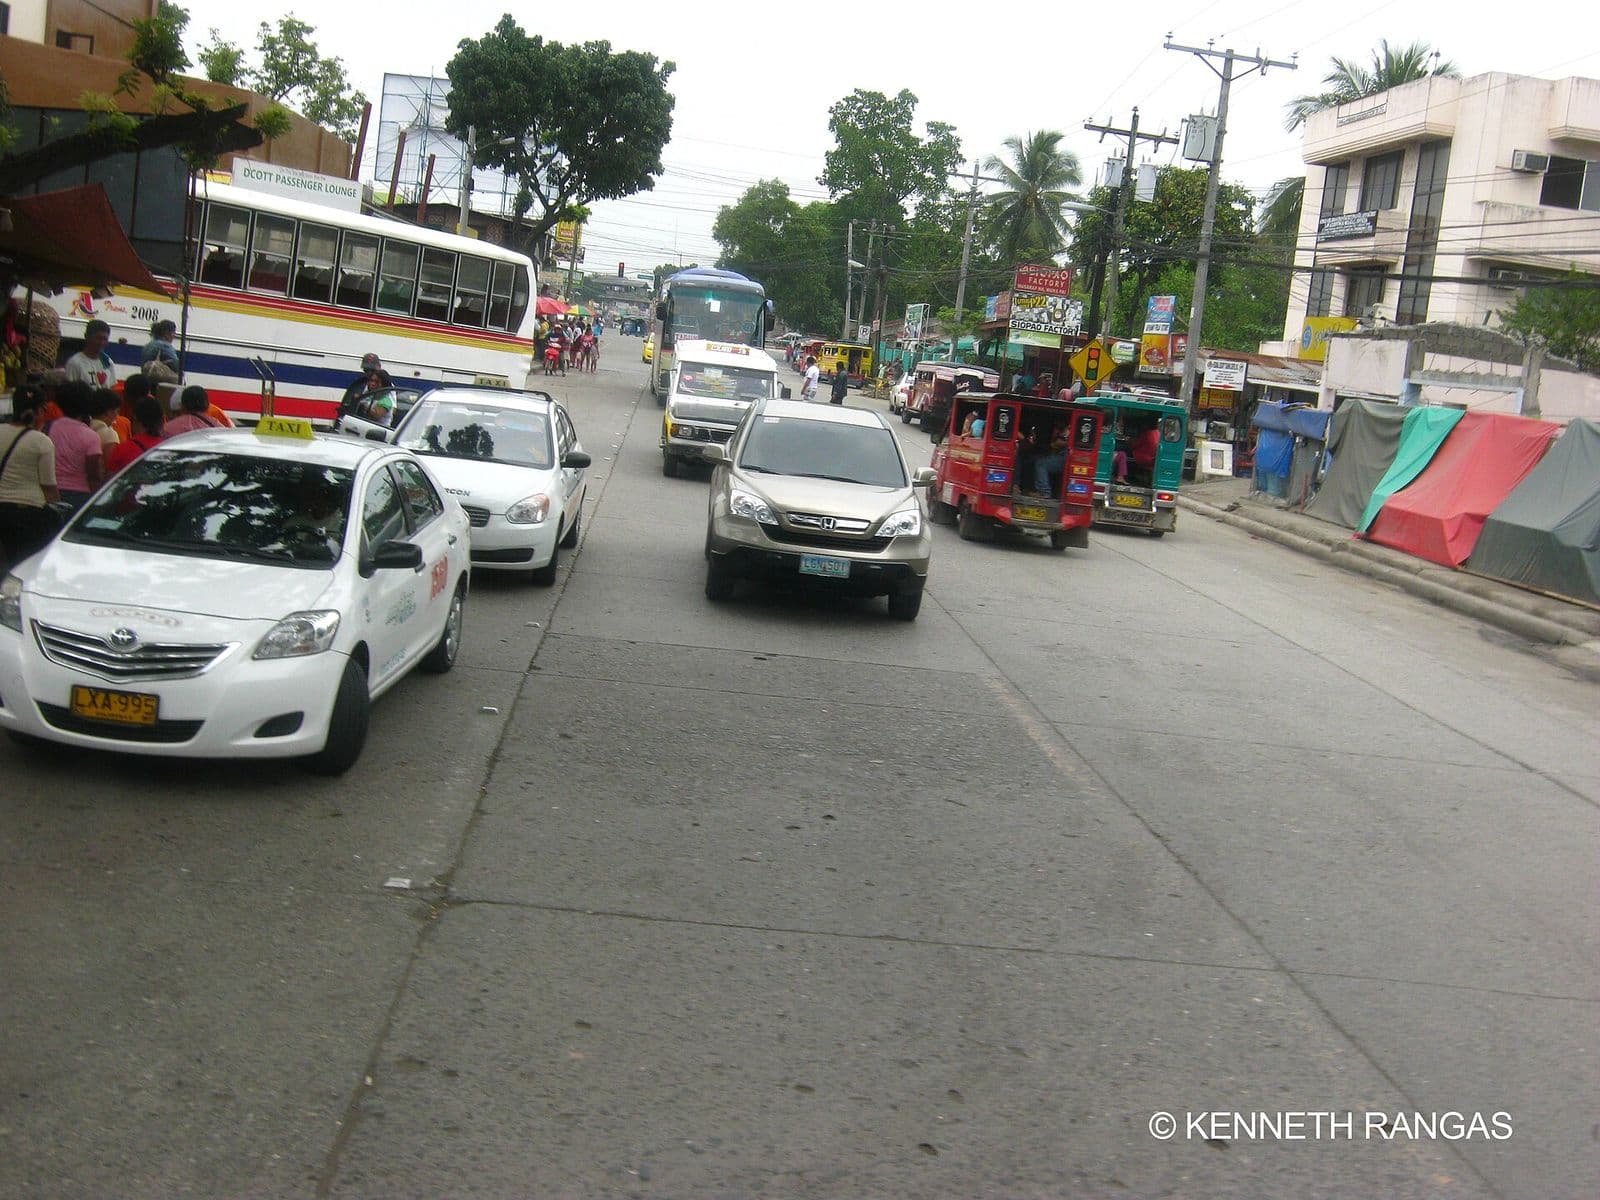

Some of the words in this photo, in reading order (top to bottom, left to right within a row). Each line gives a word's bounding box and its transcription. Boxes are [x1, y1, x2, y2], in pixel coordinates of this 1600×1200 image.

[275, 174, 323, 192] PASSENGER
[325, 184, 357, 198] LOUNGE
[1028, 276, 1065, 288] FACTORY
[131, 305, 159, 322] 2008
[1011, 320, 1042, 331] SIOPAO
[479, 378, 507, 387] TAXI
[266, 420, 301, 434] TAXI
